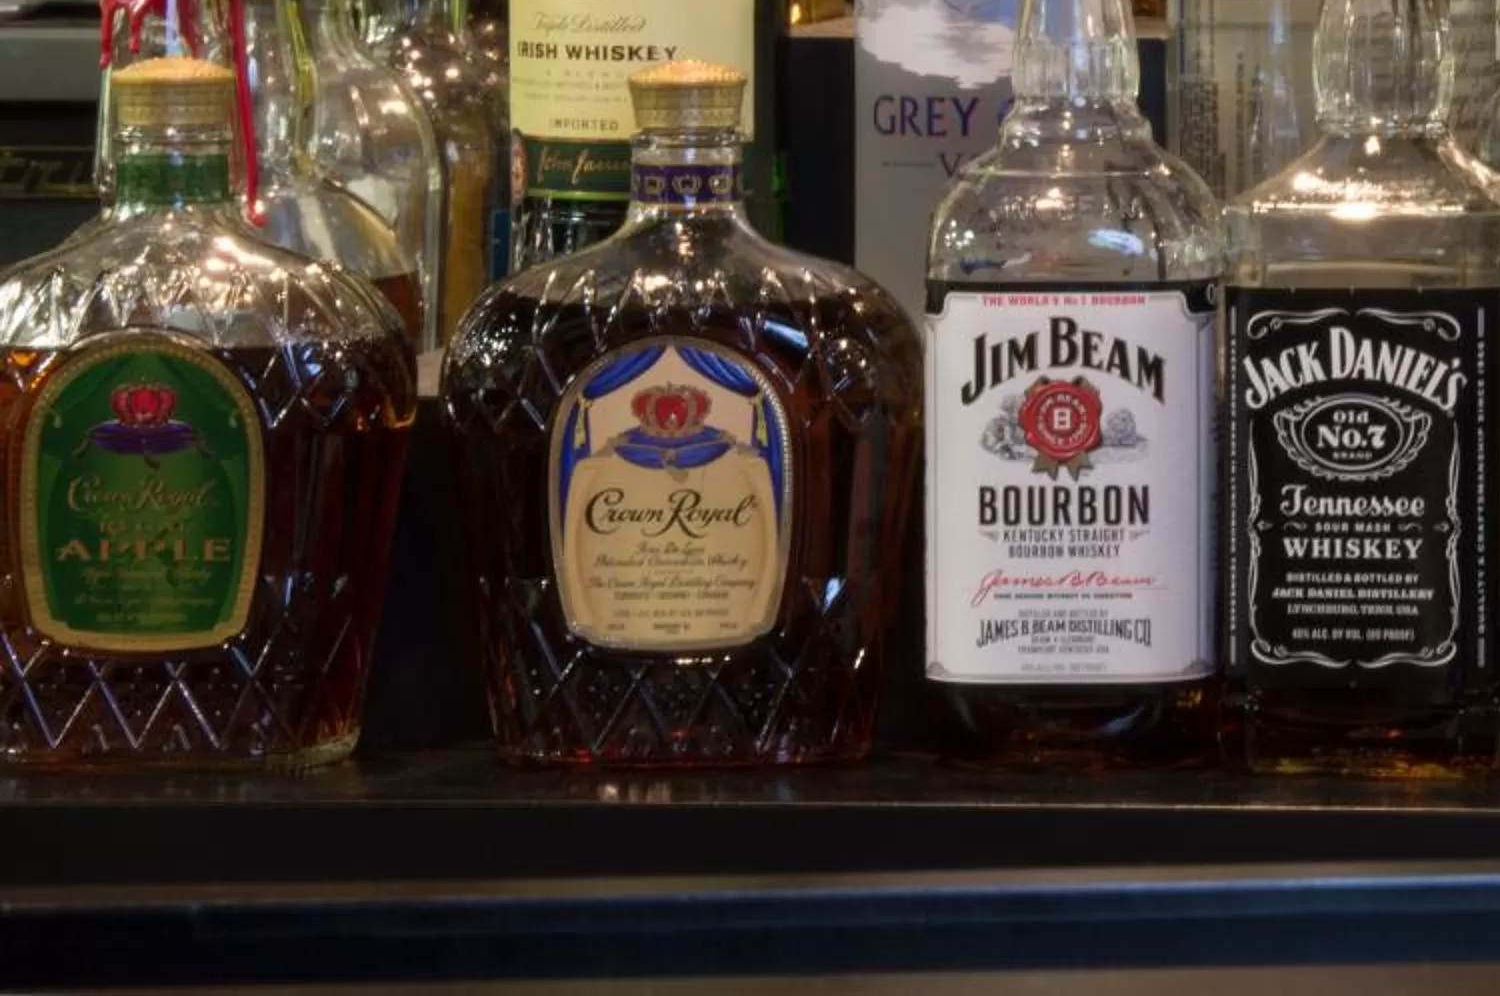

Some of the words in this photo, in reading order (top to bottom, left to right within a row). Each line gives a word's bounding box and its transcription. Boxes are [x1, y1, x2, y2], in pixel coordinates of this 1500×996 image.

[517, 39, 557, 60] IRISH
[565, 45, 678, 61] WHISKEY
[549, 118, 619, 132] IMPORTED
[873, 95, 980, 137] GREY
[961, 331, 1040, 406] JIM
[1049, 316, 1166, 406] BEAM
[1243, 340, 1327, 409] JACK
[1329, 326, 1468, 412] DANIEL'S
[1333, 410, 1369, 425] Old
[1316, 425, 1387, 450] No.7
[978, 485, 1150, 526] BOURBON
[1279, 484, 1426, 517] Tennessee
[585, 488, 664, 535] Crown
[641, 489, 758, 538] Royal
[1002, 528, 1064, 543] KENTUCKY
[1069, 528, 1125, 543] STRAIGHT
[1315, 521, 1349, 533] SOUR
[1354, 521, 1391, 533] MASH
[57, 539, 231, 562] APPLE
[1008, 544, 1064, 559] BOURBON
[1068, 544, 1121, 559] WHISKEY
[1282, 537, 1424, 560] WHISKEY
[1286, 572, 1342, 584] DISTILLED
[1354, 572, 1402, 584] BOTTLED
[1405, 573, 1419, 584] BY
[1272, 588, 1304, 600] JACK
[1307, 588, 1355, 600] DANIEL
[1358, 588, 1435, 601] DISTILLERY
[976, 619, 1018, 648] JAMES
[1032, 619, 1066, 635] BEAM
[1068, 619, 1132, 641] DISTILLING
